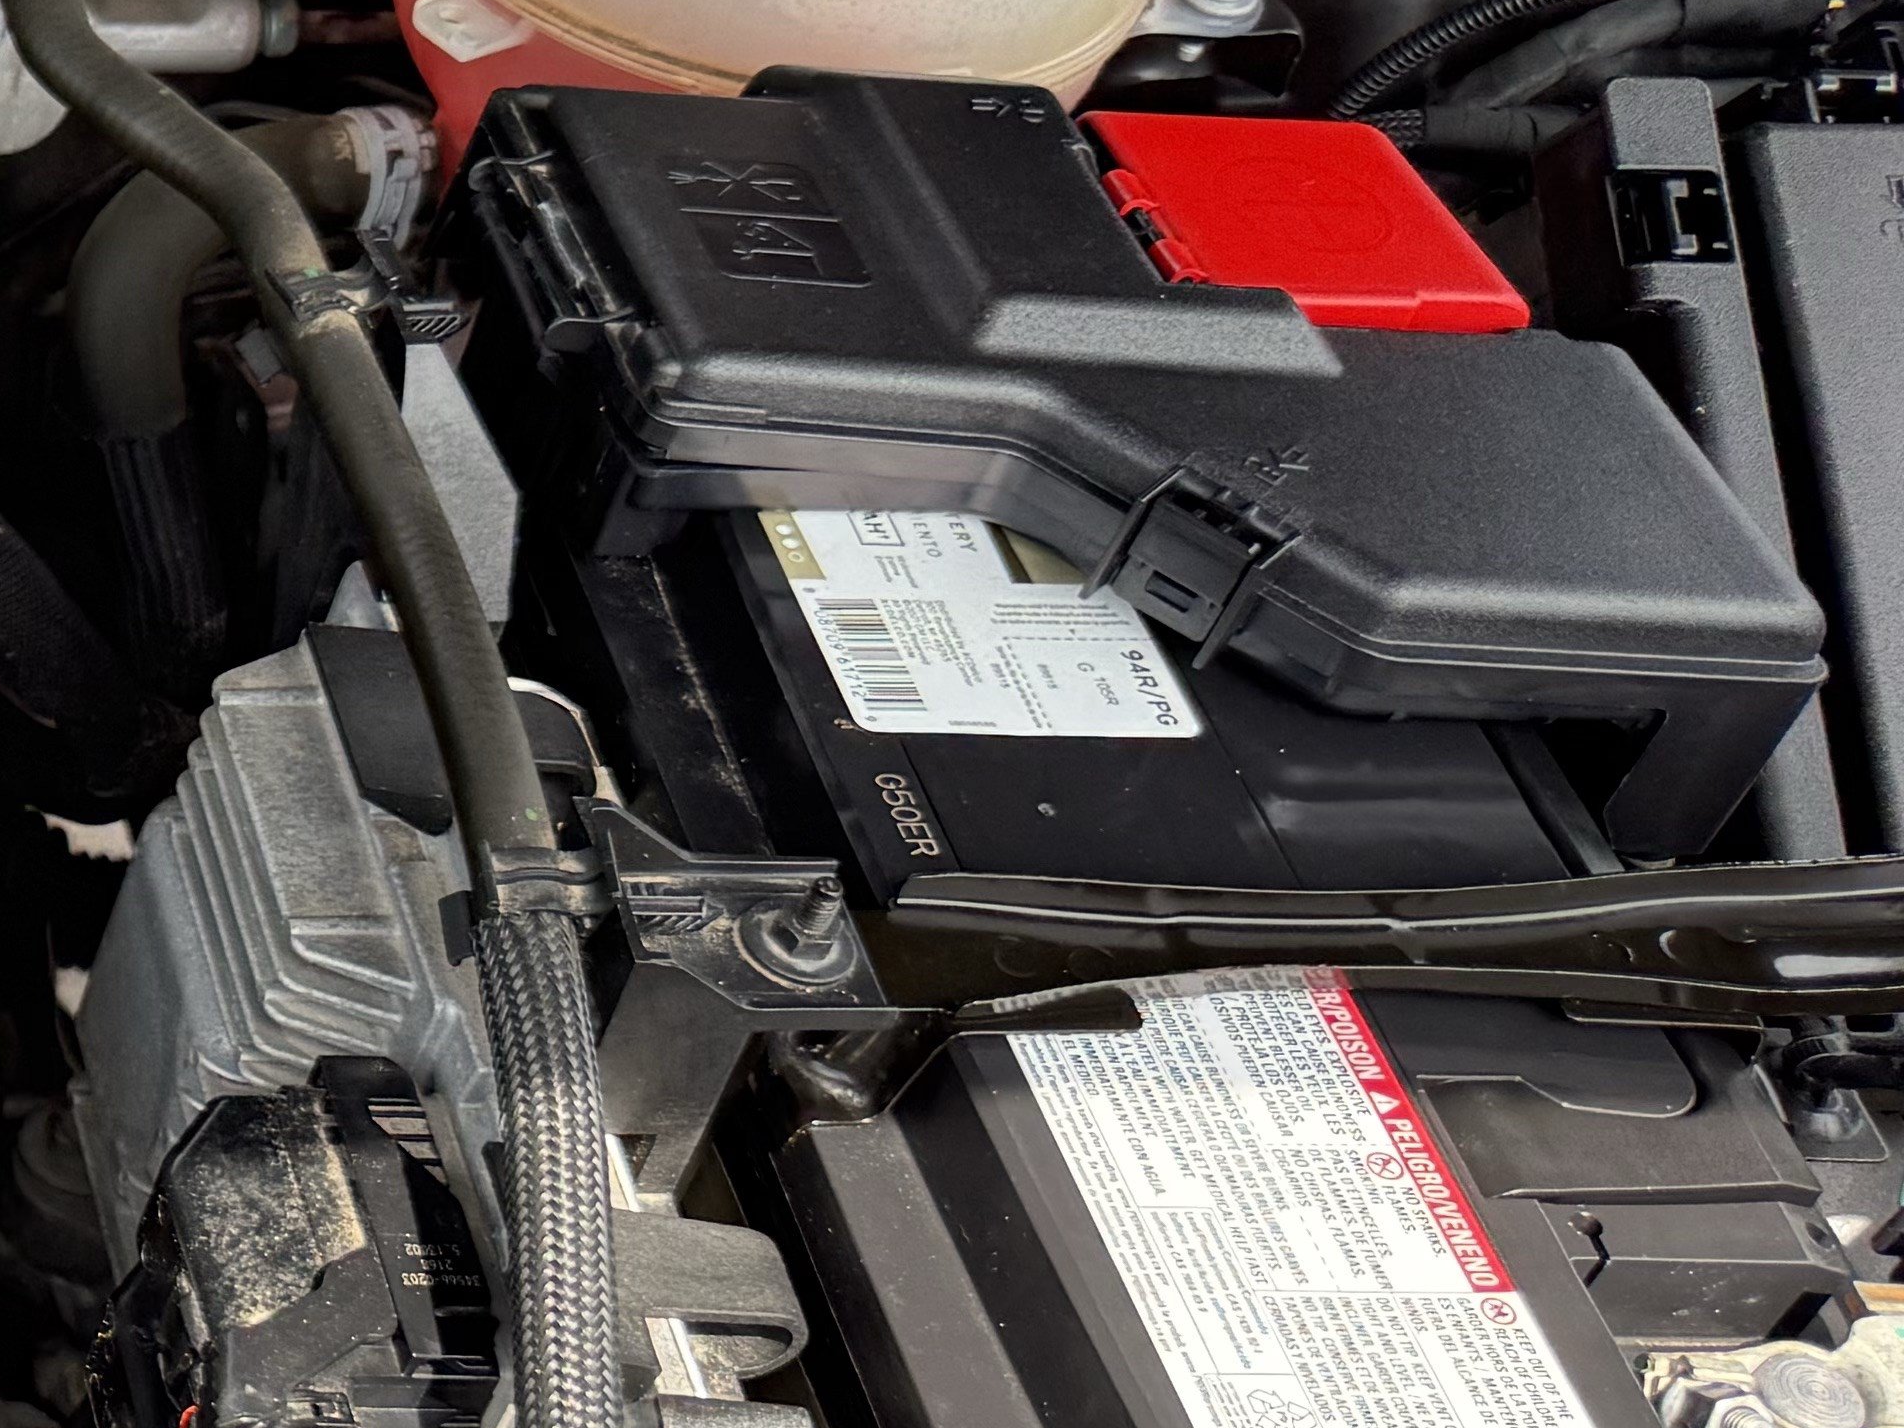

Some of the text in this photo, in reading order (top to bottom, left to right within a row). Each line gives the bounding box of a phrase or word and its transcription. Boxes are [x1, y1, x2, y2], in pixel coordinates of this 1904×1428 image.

[1119, 649, 1180, 728] 94R/PG
[874, 773, 942, 859] G50ER
[1060, 1040, 1078, 1051] EL
[1232, 1044, 1268, 1087] PUEDEN
[1284, 1011, 1309, 1033] CAN
[1299, 1040, 1331, 1074] CAUSE
[1258, 1063, 1285, 1084] LOS
[1286, 1050, 1346, 1135] LES LES
[1293, 1095, 1315, 1110] OU
[1126, 1137, 1150, 1160] CON
[1324, 1149, 1350, 1173] PAS
[1150, 1075, 1176, 1103] WITH
[1188, 1150, 1210, 1169] GET
[1200, 1173, 1237, 1222] MEDICAL
[1227, 1226, 1253, 1253] HELP
[1242, 1257, 1268, 1284] FAST
[1306, 1149, 1327, 1162] DE
[1348, 1230, 1370, 1245] DE
[1343, 1149, 1384, 1204] SMOKING
[1379, 1118, 1501, 1285] PELIGRO/VENENO
[1398, 1186, 1422, 1205] NO
[1299, 1296, 1319, 1311] NO
[1305, 1346, 1324, 1358] DE
[1356, 1298, 1385, 1327] TIGHT
[1374, 1331, 1399, 1354] AND
[1410, 1401, 1430, 1414] NE
[1375, 1297, 1395, 1311] DO
[1385, 1316, 1409, 1336] NOT
[1409, 1363, 1436, 1389] KEEP
[1425, 1393, 1453, 1421] VENT
[1417, 1297, 1448, 1330] FUERA
[1437, 1334, 1460, 1353] DEL
[1449, 1356, 1488, 1406] ALCANCE
[1477, 1410, 1498, 1424] DE
[1480, 1343, 1509, 1372] HORS
[1492, 1328, 1523, 1363] REACH
[1512, 1366, 1532, 1379] OF
[1511, 1328, 1574, 1419] KEEP OUT OF THE
[1497, 1376, 1518, 1389] DE
[1507, 1393, 1527, 1406] LA
